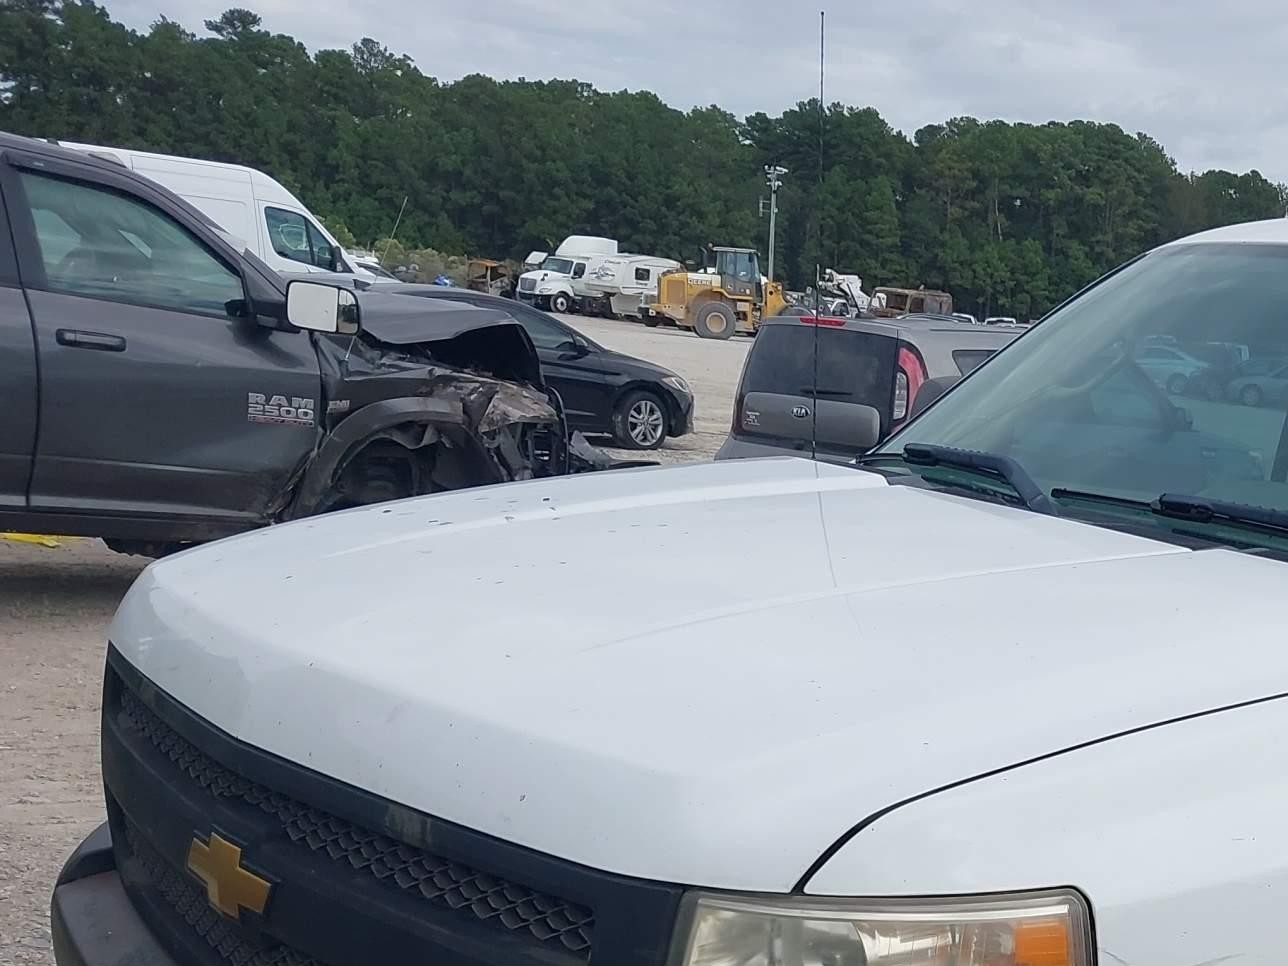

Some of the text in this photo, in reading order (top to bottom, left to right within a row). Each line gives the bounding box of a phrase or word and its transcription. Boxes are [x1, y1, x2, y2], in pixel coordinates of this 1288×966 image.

[247, 392, 315, 410] RAM
[247, 403, 314, 420] 2500
[792, 406, 809, 418] KIA
